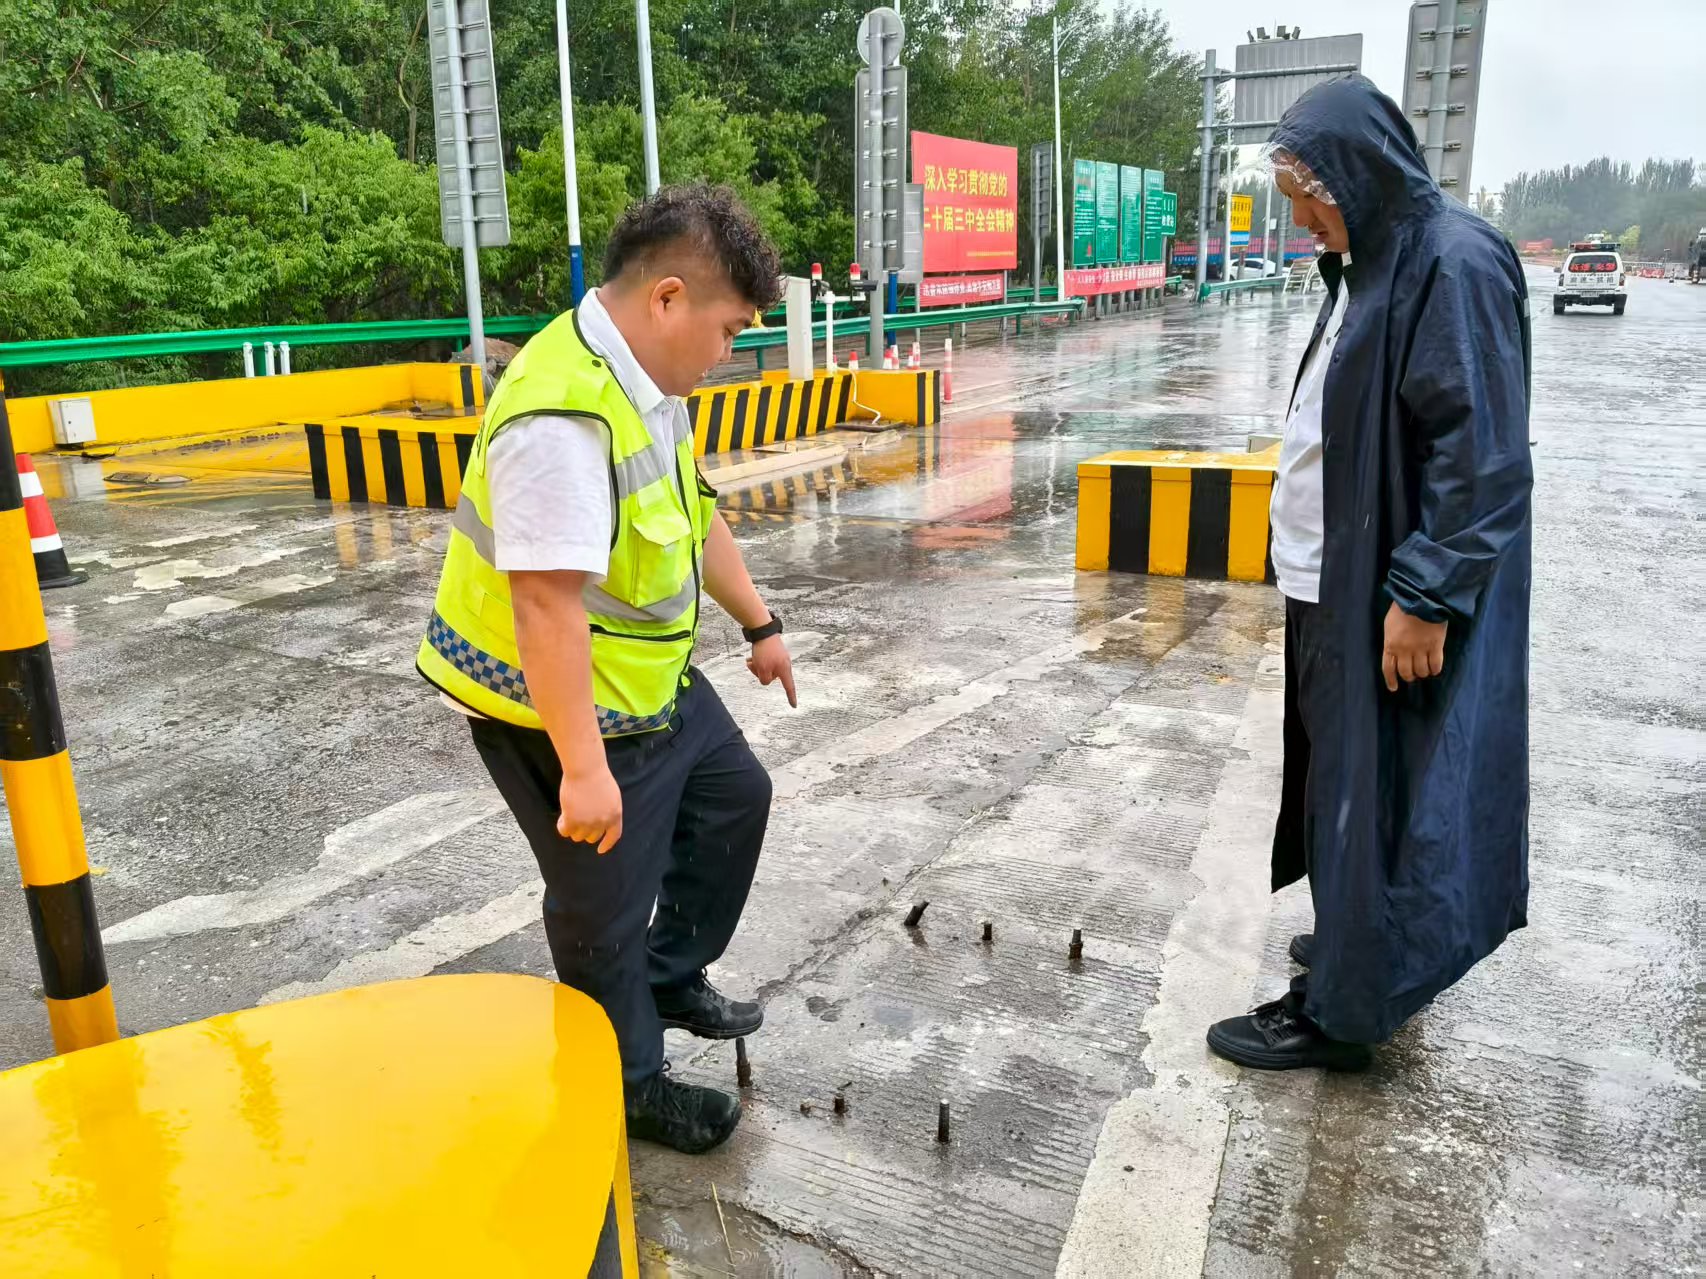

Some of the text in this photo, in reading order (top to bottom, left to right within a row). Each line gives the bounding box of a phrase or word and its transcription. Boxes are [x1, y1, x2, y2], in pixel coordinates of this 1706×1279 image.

[924, 165, 1008, 197] 深入学习贯彻党的
